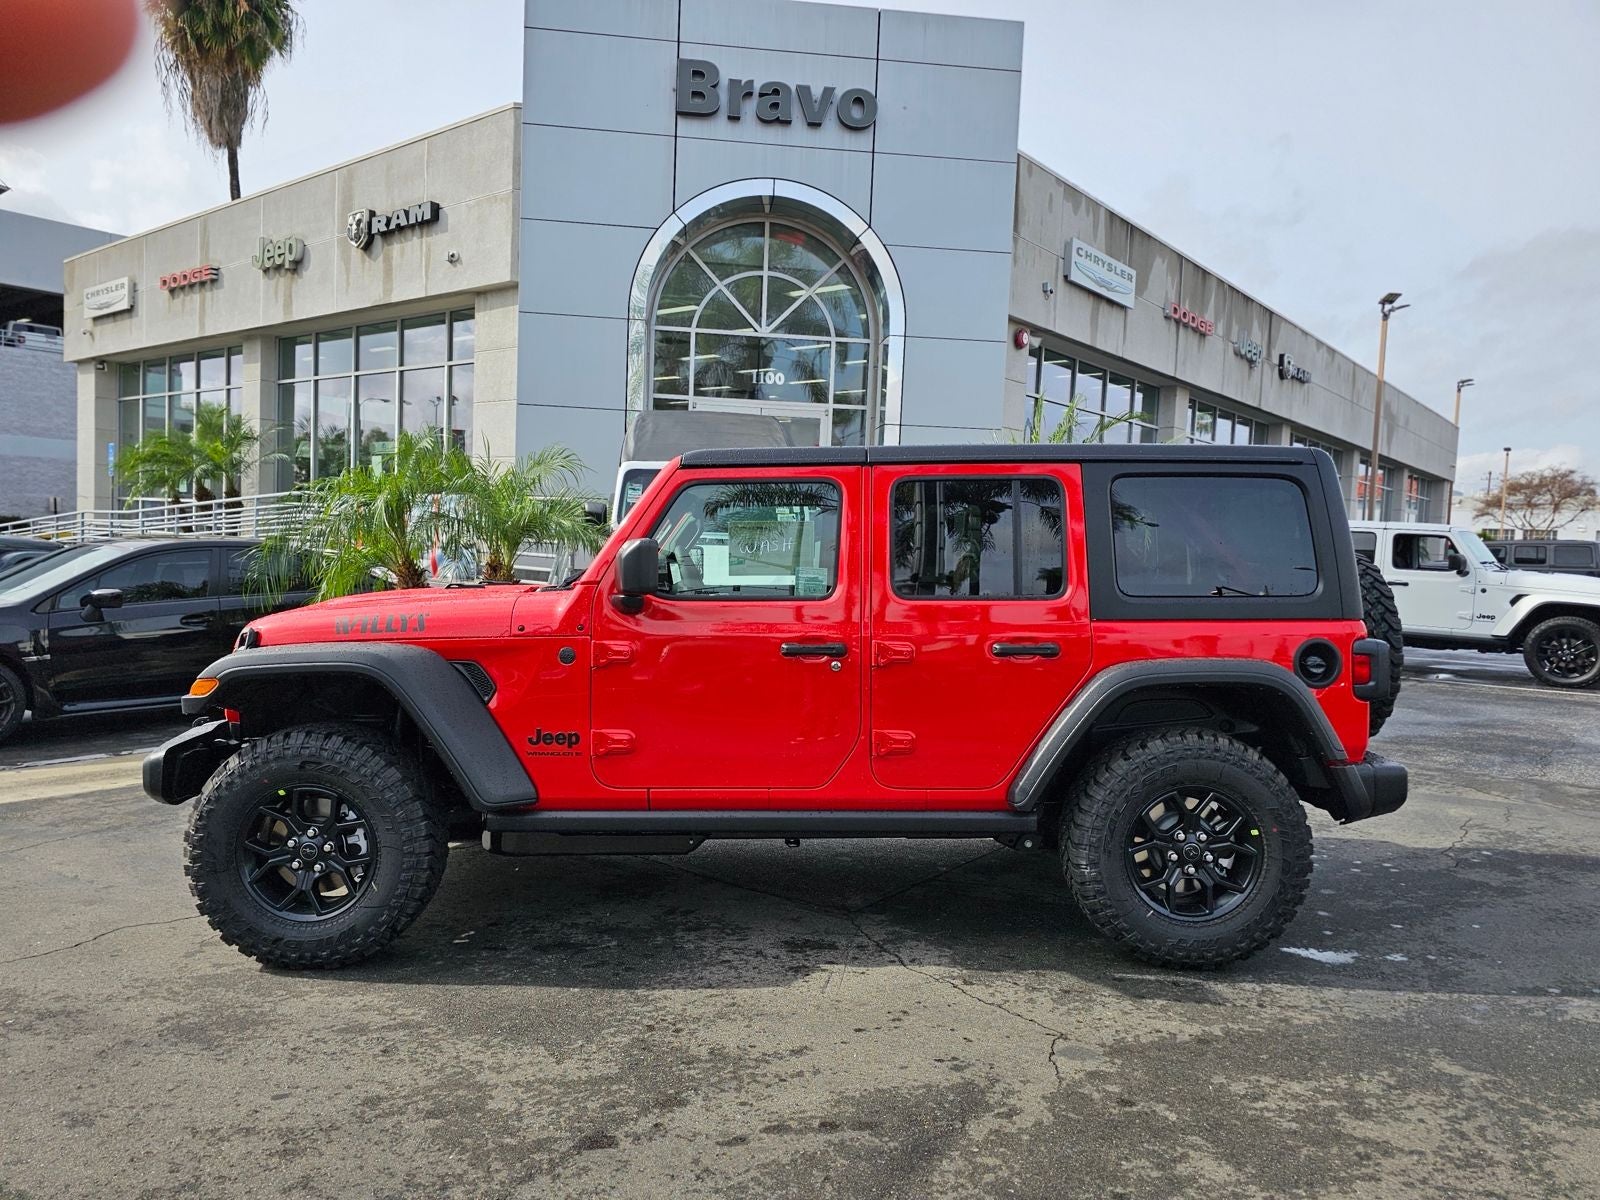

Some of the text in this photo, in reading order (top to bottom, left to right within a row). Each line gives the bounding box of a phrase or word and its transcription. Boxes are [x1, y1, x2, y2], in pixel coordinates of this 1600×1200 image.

[677, 58, 878, 130] Bravo
[371, 200, 435, 235] RAM
[252, 235, 304, 271] Jeep
[1076, 246, 1134, 283] CHRYSLER
[160, 265, 217, 290] DODGE
[85, 282, 126, 300] CHRYSLER
[1170, 303, 1215, 336] DODGE
[1239, 328, 1263, 369] Jeep
[752, 370, 785, 386] 1100
[740, 537, 794, 555] WASH
[335, 612, 430, 635] WILLYS
[1476, 613, 1496, 621] Jeep
[527, 728, 580, 749] Jeep
